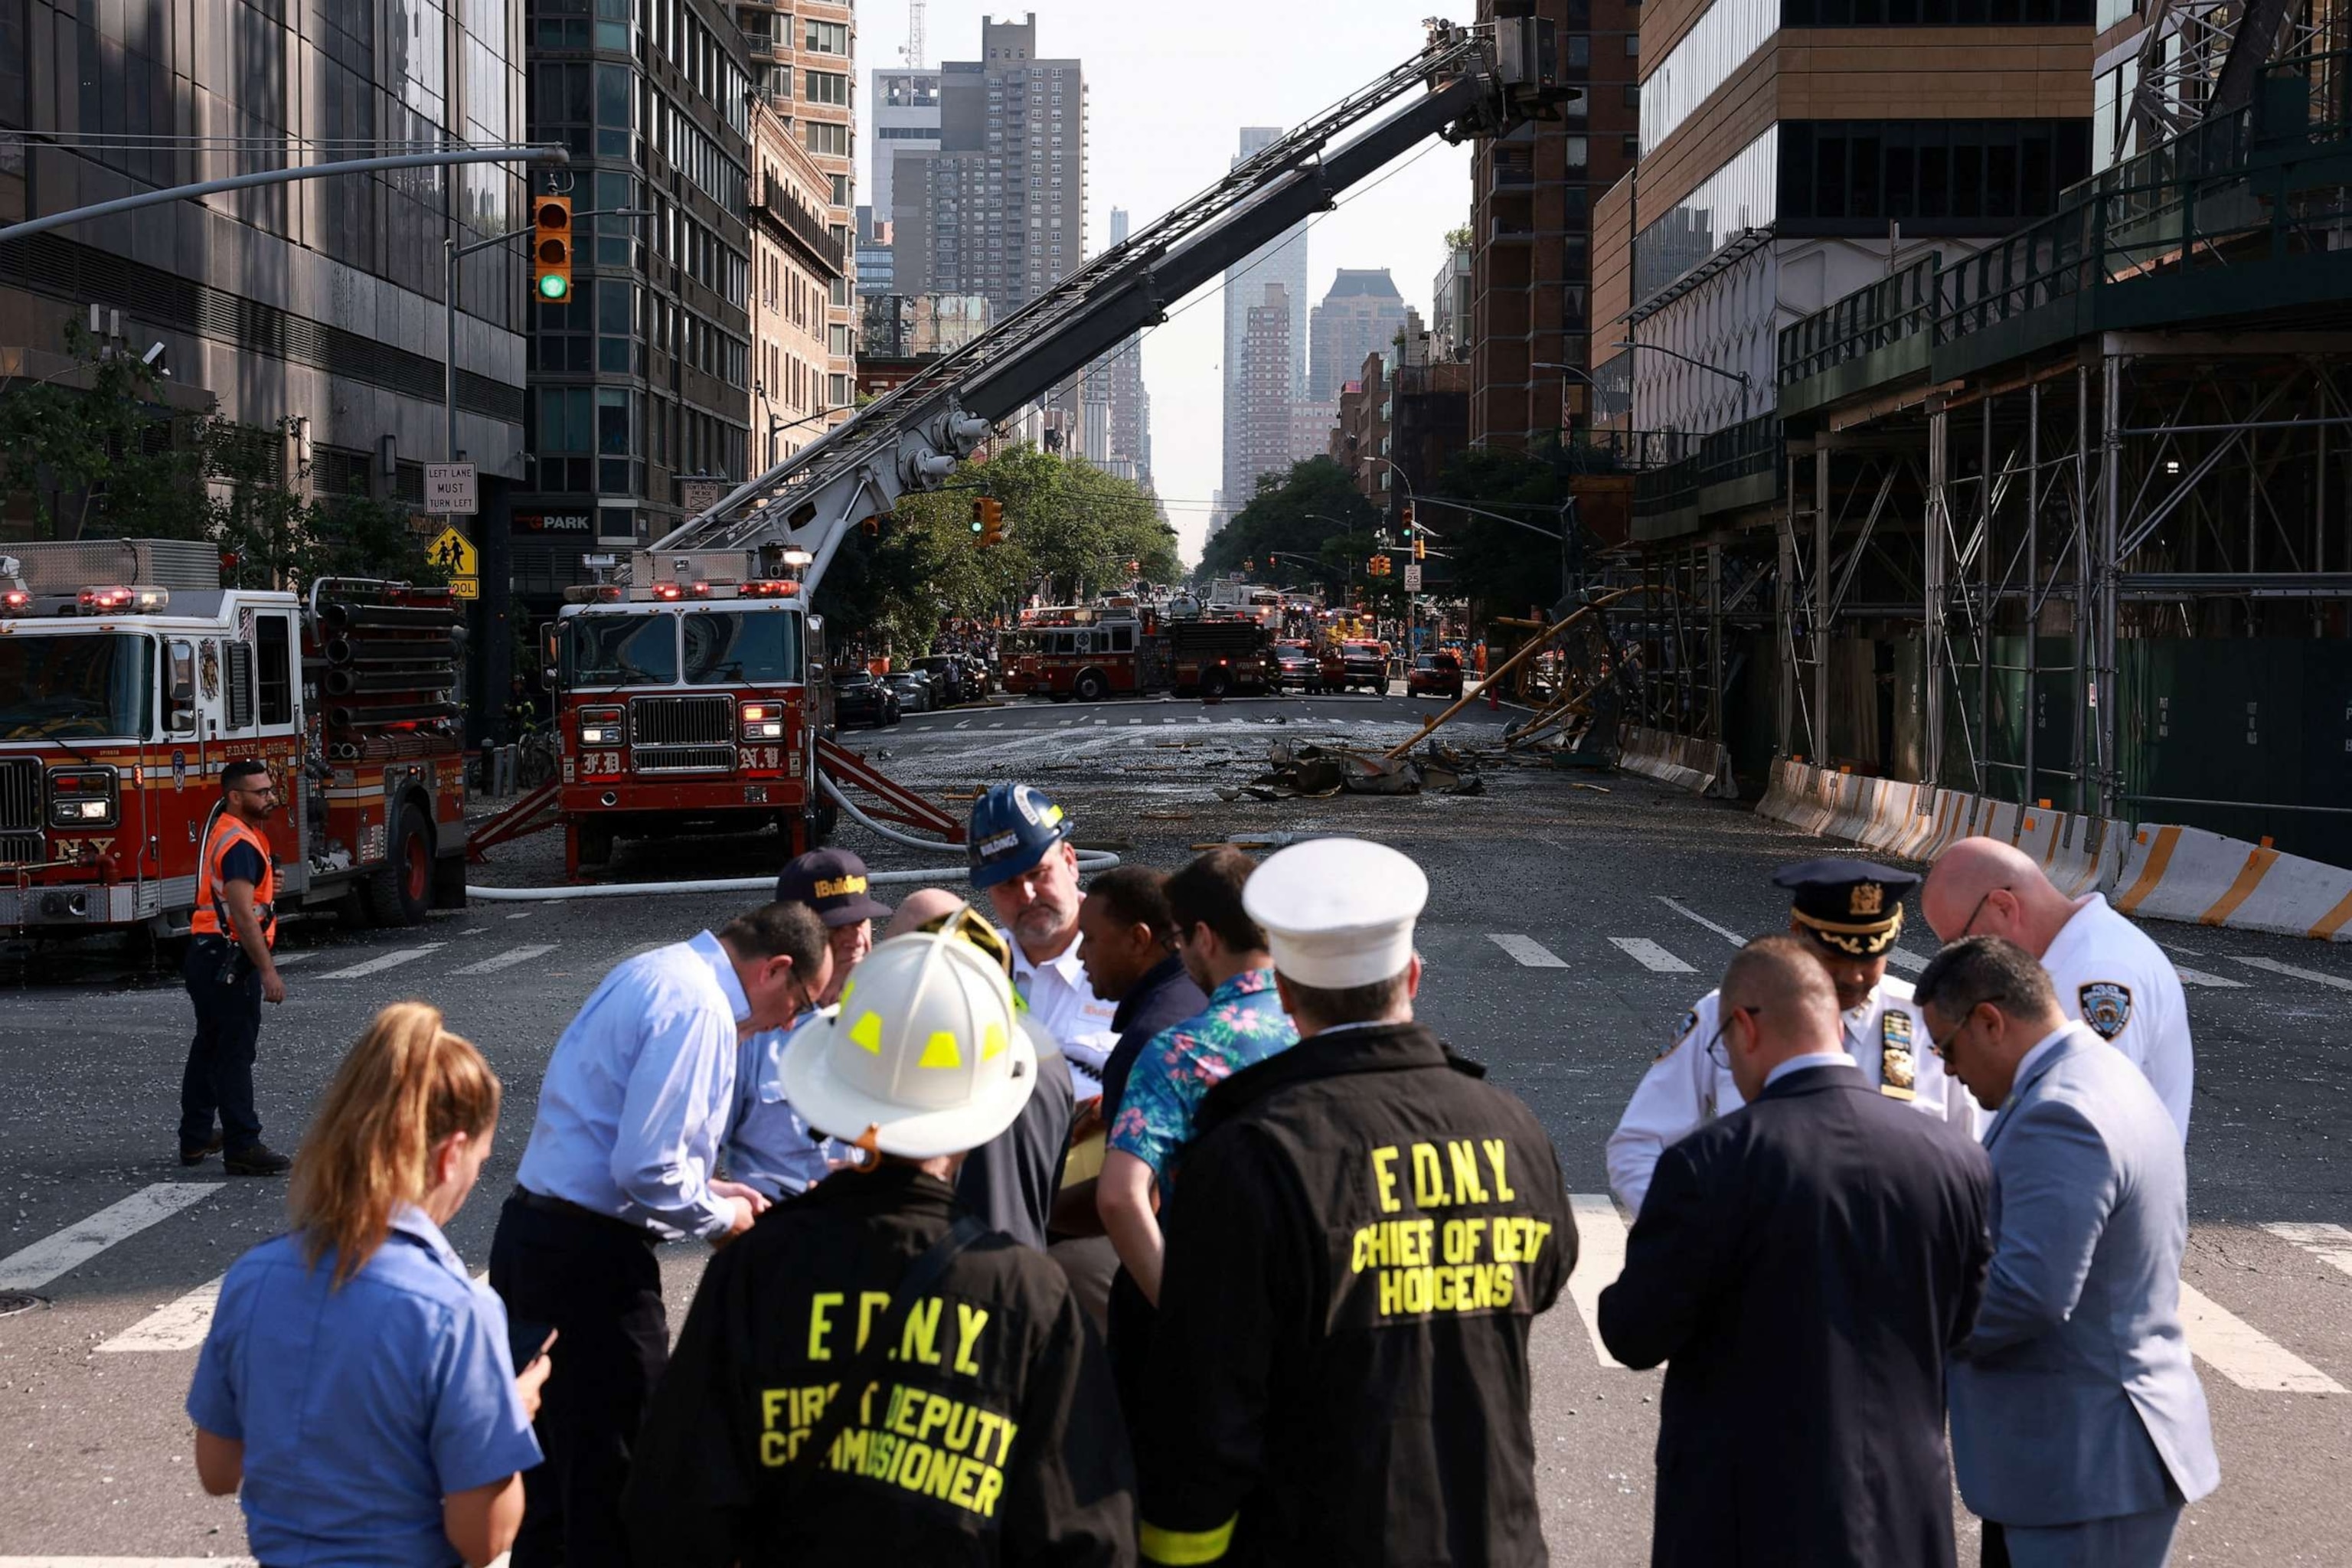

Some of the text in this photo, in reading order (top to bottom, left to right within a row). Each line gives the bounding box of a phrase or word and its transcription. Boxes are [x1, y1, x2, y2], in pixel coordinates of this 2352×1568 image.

[429, 469, 472, 478] LEFT LANE
[437, 483, 464, 494] MUST
[430, 499, 472, 508] TURN LEFT
[544, 516, 589, 529] PARK
[1407, 575, 1419, 583] 25
[450, 583, 475, 593] OOL
[582, 751, 628, 775] F.D.
[55, 837, 121, 861] NY.
[1351, 1217, 1552, 1274] CHIEF OF DET
[762, 1381, 1018, 1461] FIRT DEPUTY
